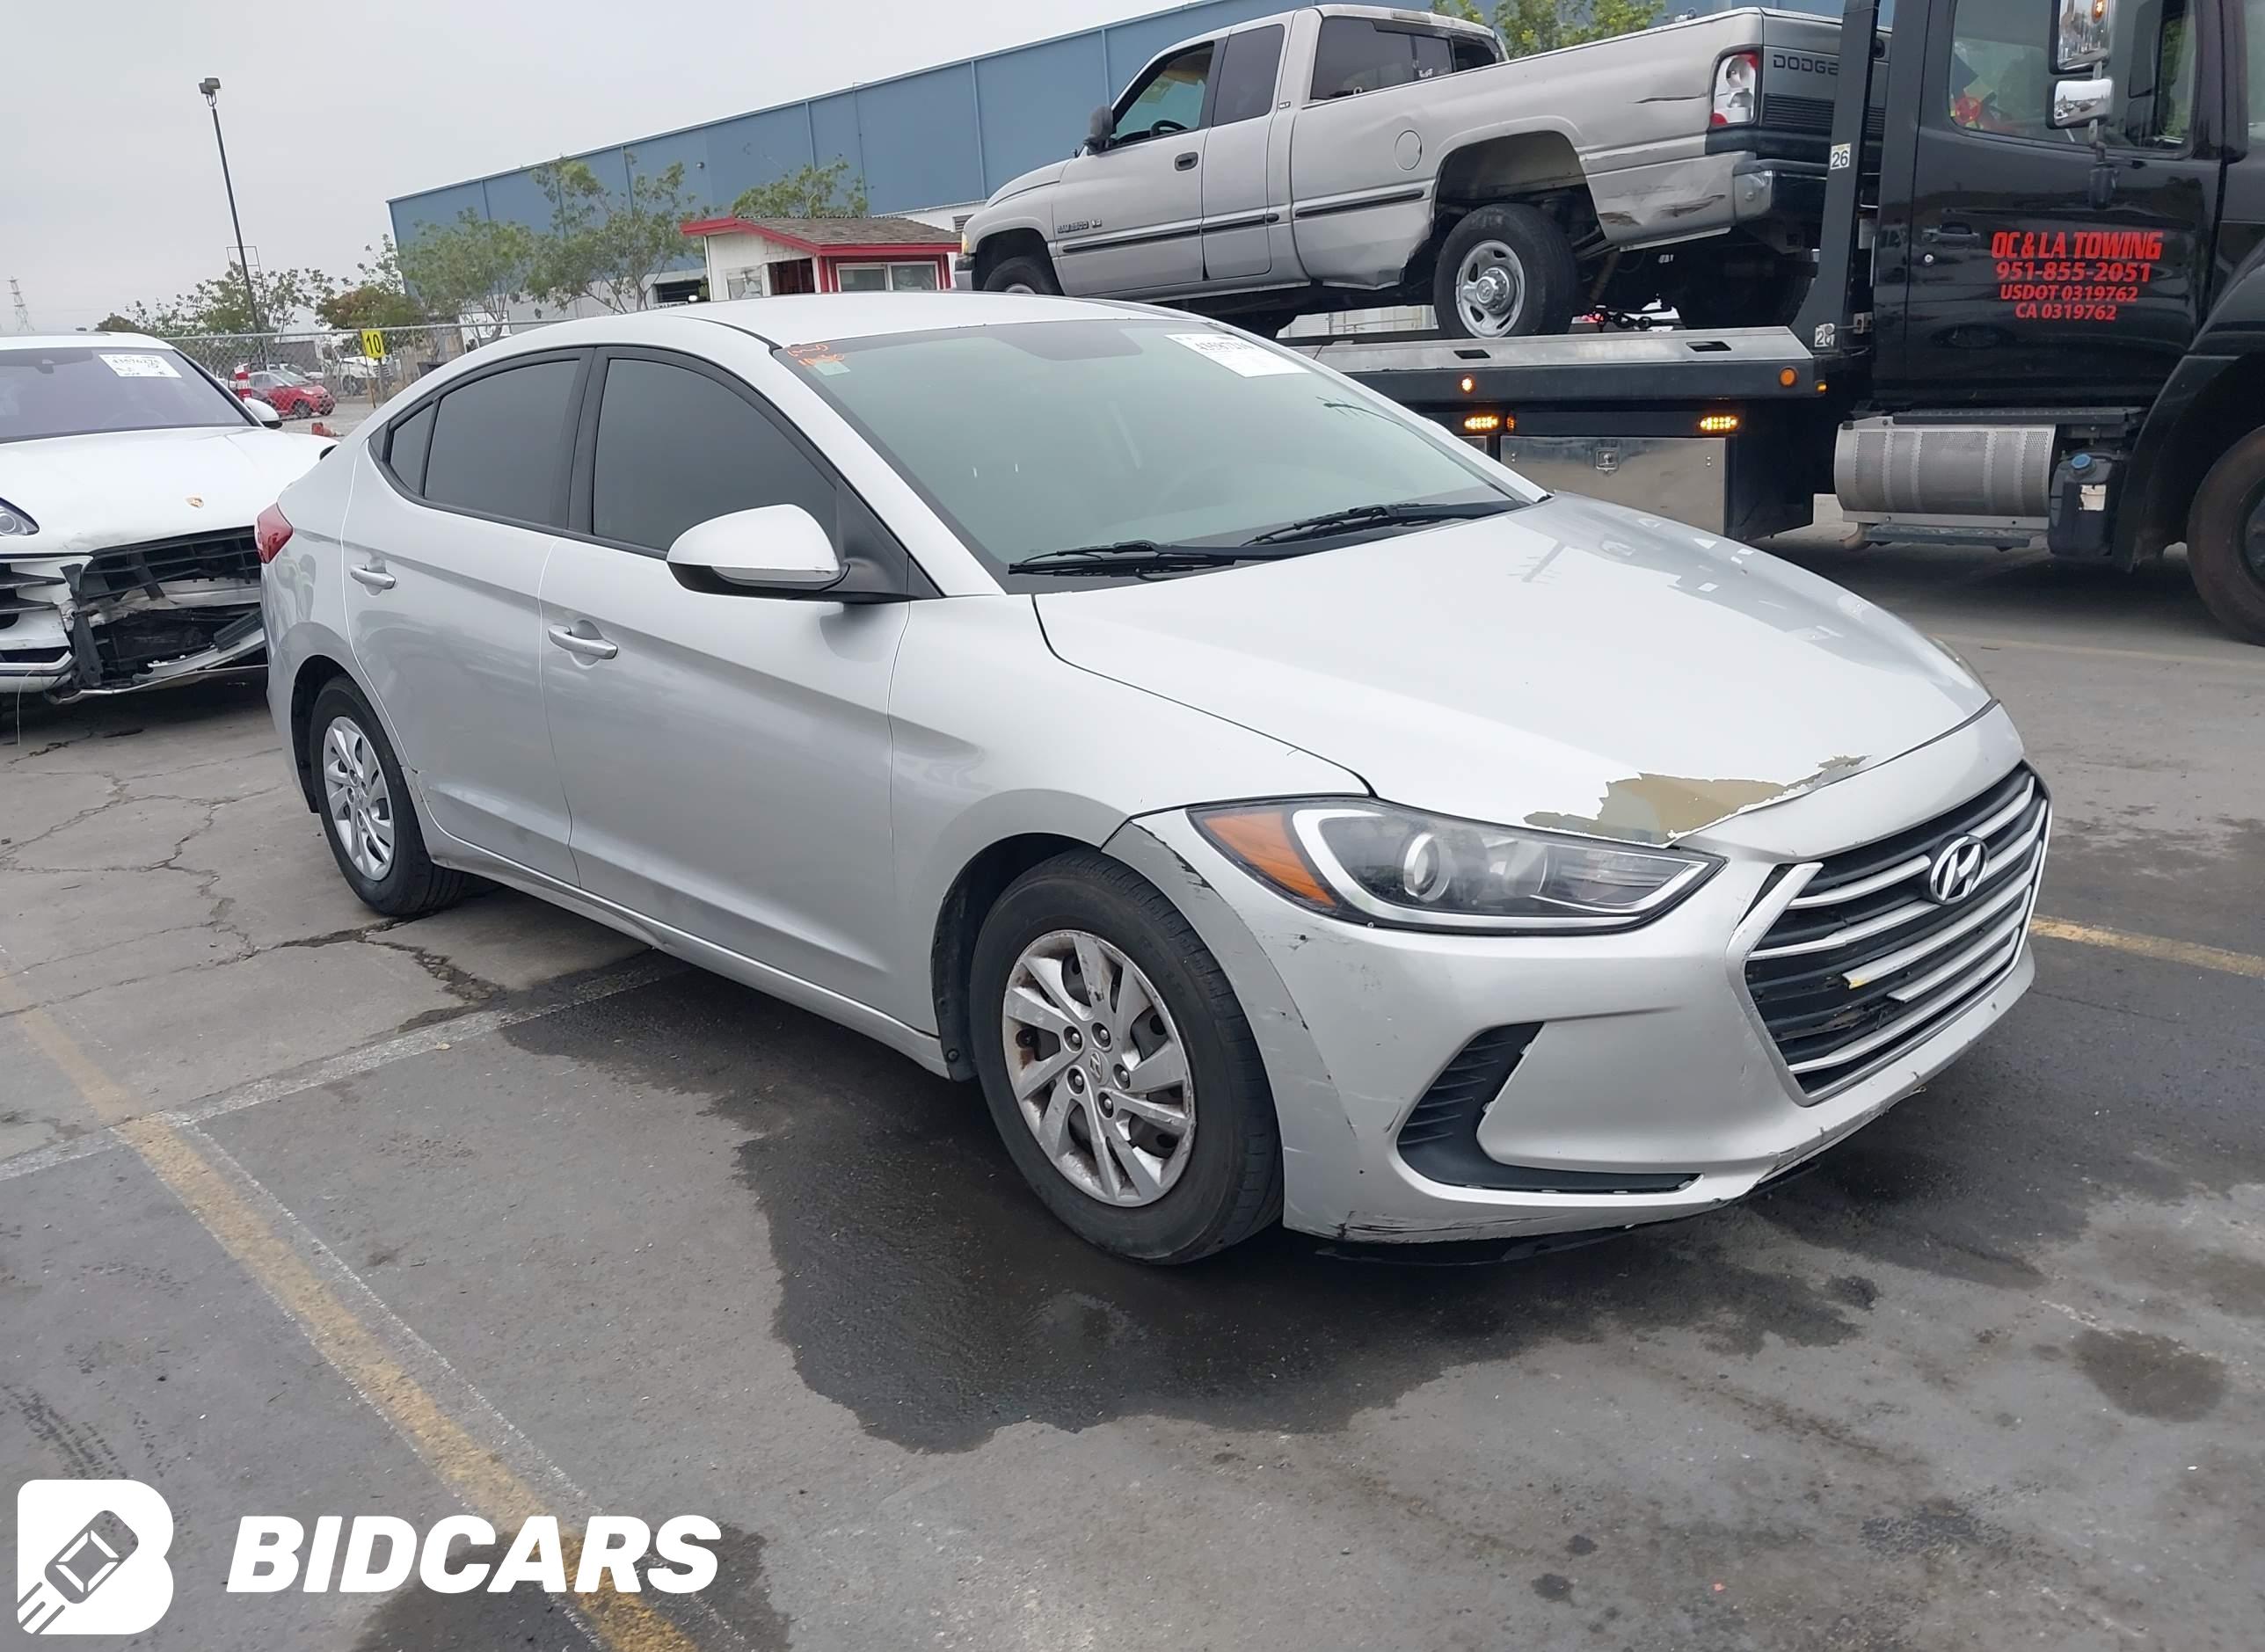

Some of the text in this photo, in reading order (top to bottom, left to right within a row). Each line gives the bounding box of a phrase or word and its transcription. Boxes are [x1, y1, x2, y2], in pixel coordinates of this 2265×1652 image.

[1773, 55, 1839, 76] DODGE
[1832, 150, 1849, 167] 26
[1991, 231, 2164, 260] OC & LA TOWING
[1996, 261, 2152, 282] 951-855-2051
[2000, 284, 2138, 302] USDOT 0319762
[2015, 302, 2117, 321] CA 0319762
[367, 334, 382, 354] 10
